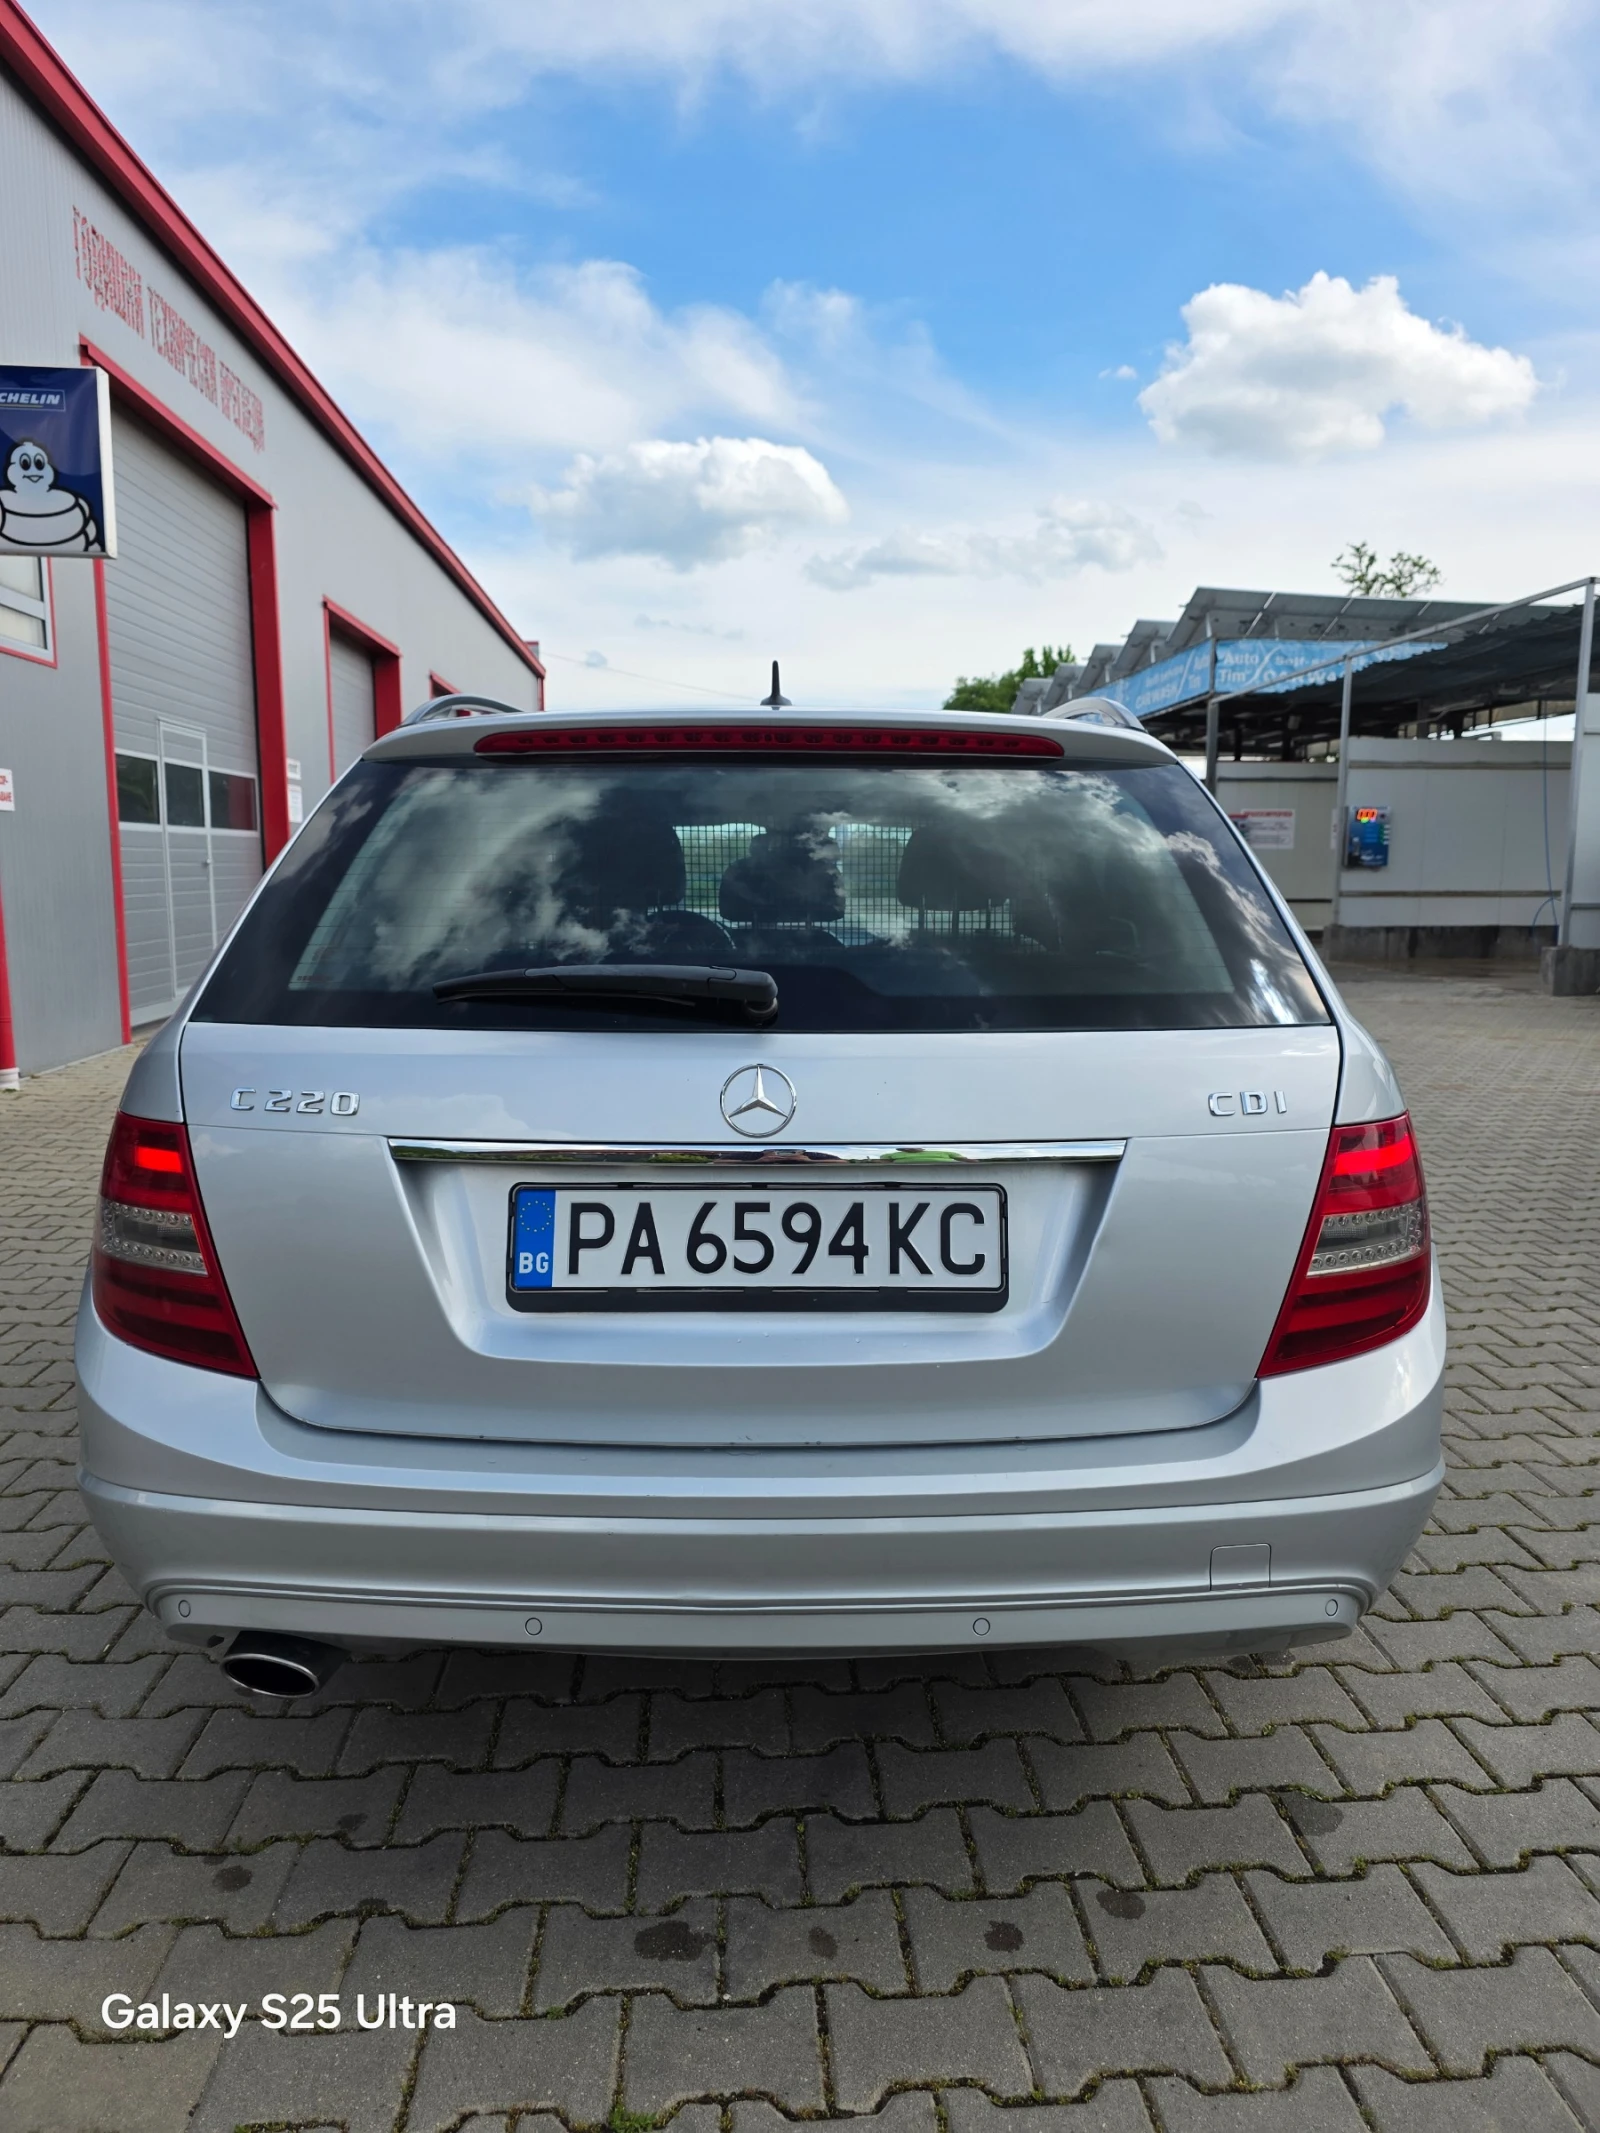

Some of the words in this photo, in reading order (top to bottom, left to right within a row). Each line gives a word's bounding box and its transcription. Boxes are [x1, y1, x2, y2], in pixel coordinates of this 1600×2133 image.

[1208, 1090, 1288, 1116] CDI
[567, 1202, 666, 1275] PA
[687, 1202, 869, 1275] 6594
[889, 1202, 986, 1275] KC
[519, 1251, 549, 1274] BG
